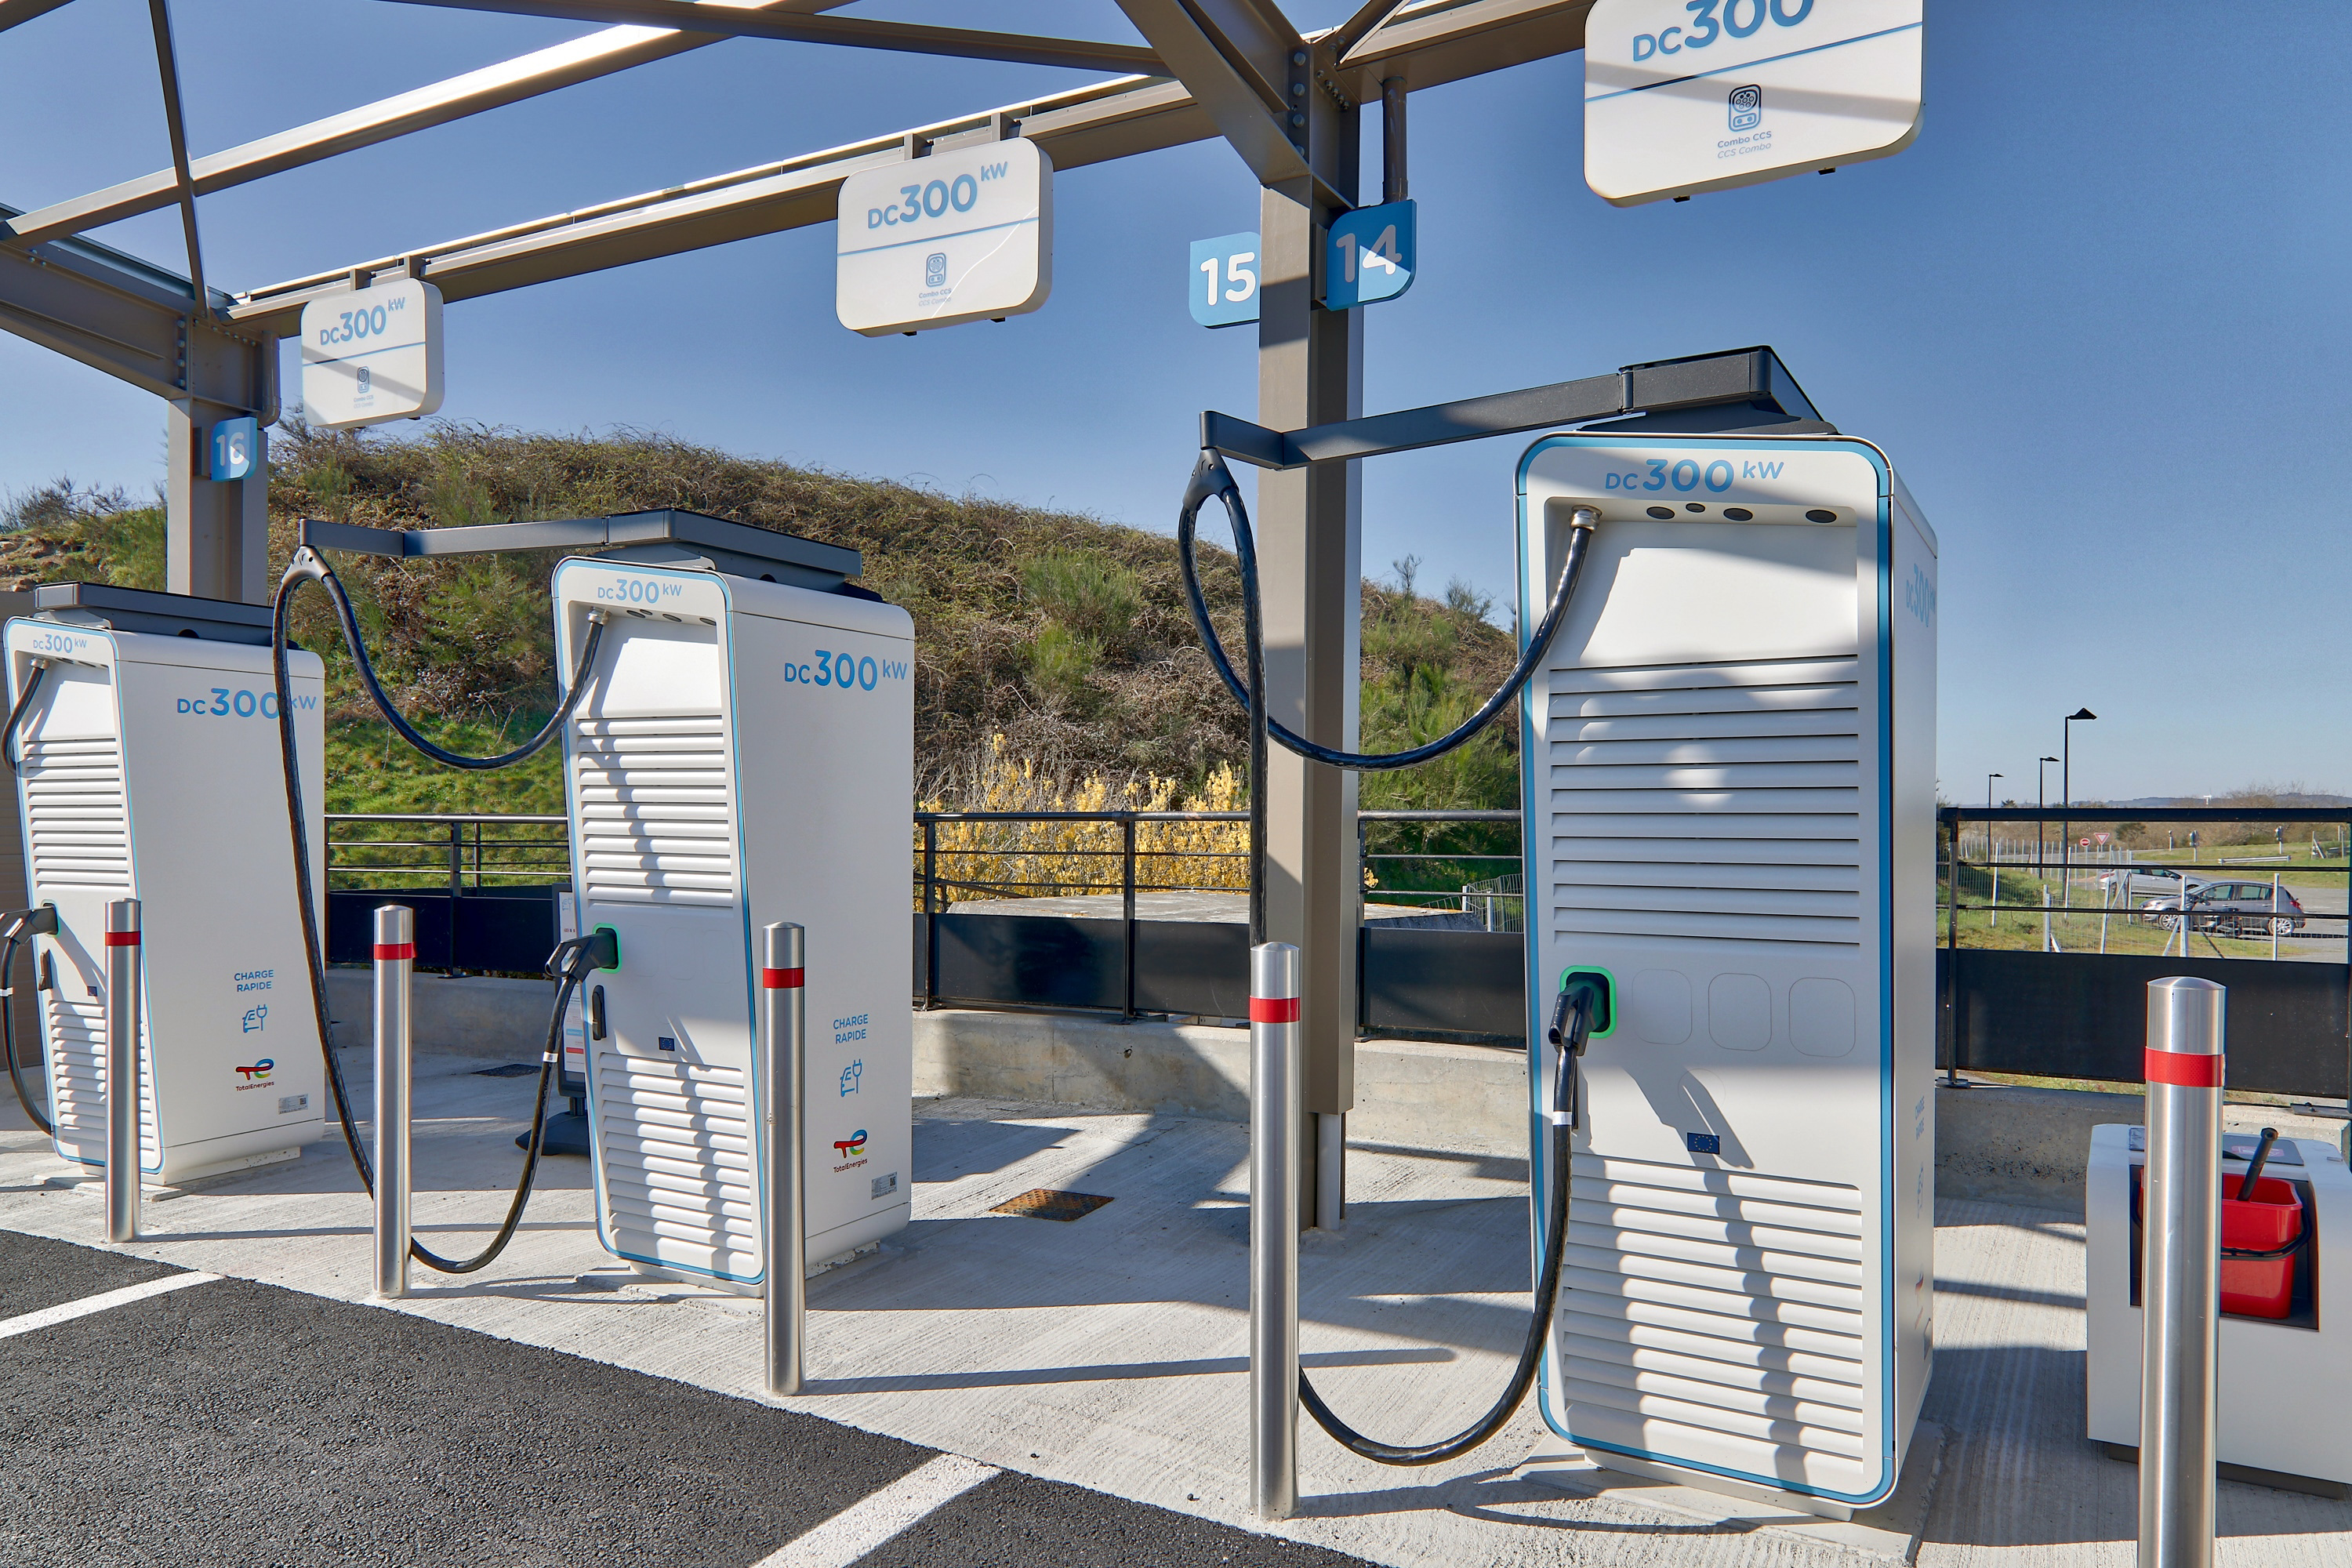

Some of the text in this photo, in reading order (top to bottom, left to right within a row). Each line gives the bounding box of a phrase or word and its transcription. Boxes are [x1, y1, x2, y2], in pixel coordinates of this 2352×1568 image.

[1717, 130, 1772, 148] Combo CCS
[1717, 143, 1772, 158] CCS Combo
[1336, 224, 1403, 283] 14
[1200, 252, 1256, 306] 15
[216, 432, 245, 466] 16
[234, 969, 274, 981] CHARGE
[237, 981, 272, 992] RAPIDE
[833, 1014, 869, 1029] CHARGE
[835, 1029, 866, 1044] RAPIDE
[235, 1081, 274, 1091] TotalEnergies
[833, 1158, 868, 1174] TotalEnergies
